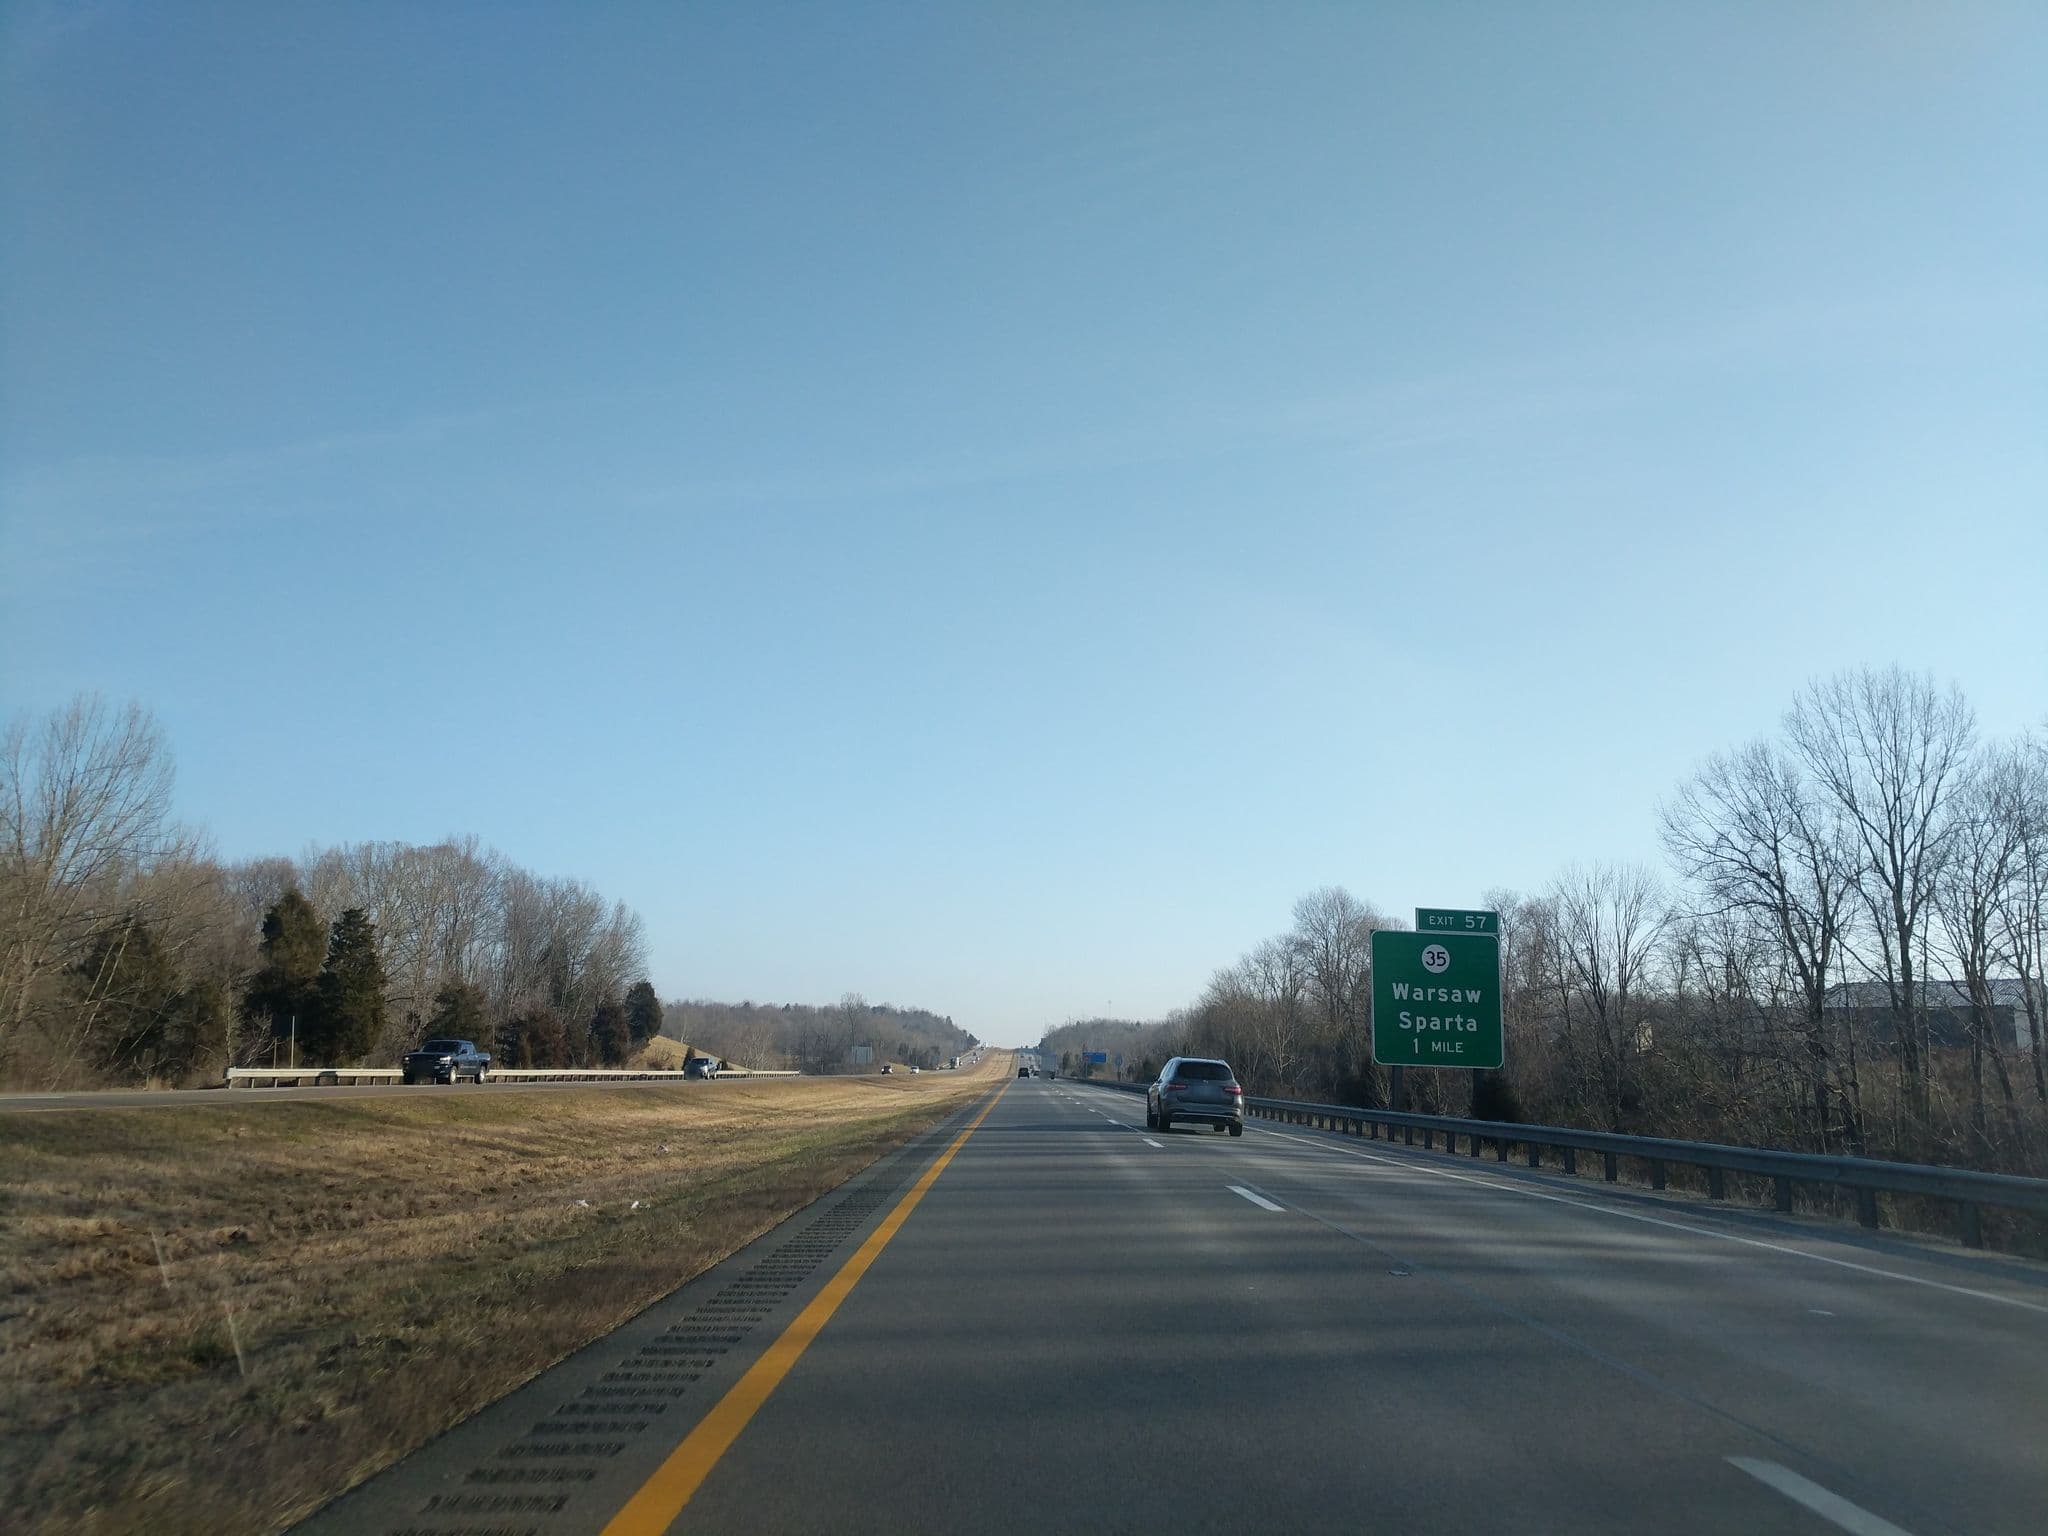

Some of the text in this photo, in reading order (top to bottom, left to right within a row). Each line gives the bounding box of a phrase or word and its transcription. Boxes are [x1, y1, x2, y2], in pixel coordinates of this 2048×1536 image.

[1429, 915, 1486, 929] EXIT 57
[1425, 950, 1446, 967] 35
[1392, 982, 1482, 1004] Warsaw
[1399, 1011, 1477, 1033] Sparta
[1413, 1038, 1464, 1054] 1 MILE
